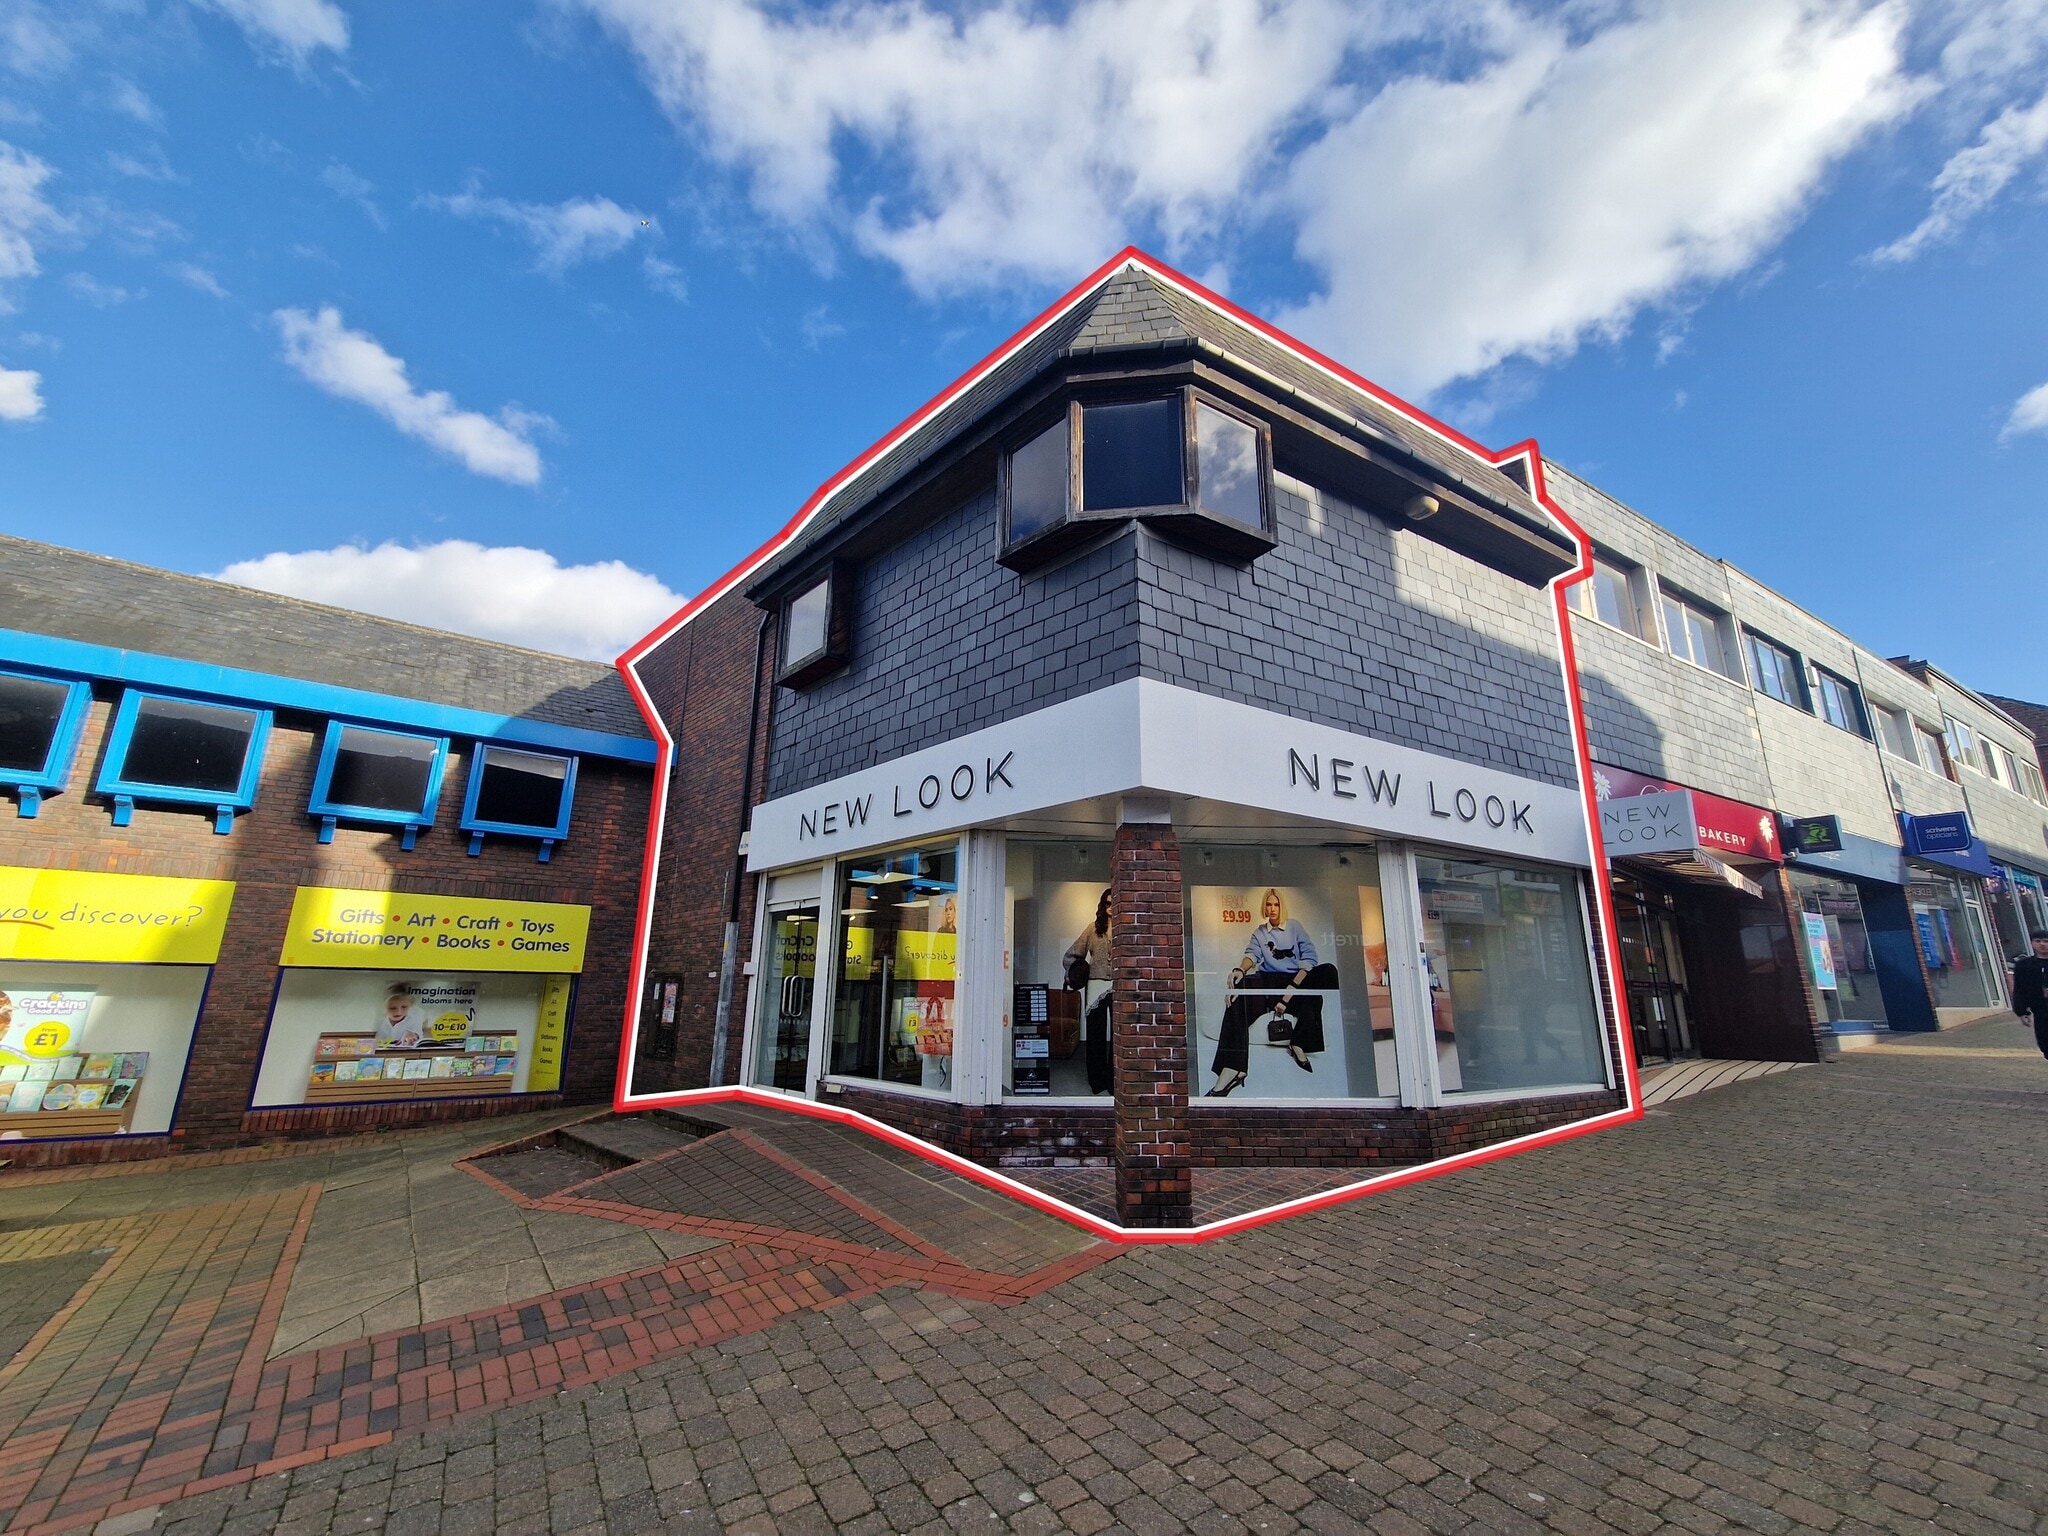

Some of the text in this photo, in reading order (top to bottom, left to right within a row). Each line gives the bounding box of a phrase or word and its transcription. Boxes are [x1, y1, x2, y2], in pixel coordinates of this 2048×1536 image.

[799, 750, 1015, 841] NEW LOOK
[1288, 747, 1534, 835] NEW LOOK
[1603, 803, 1670, 825] NEW
[1698, 826, 1746, 847] BAKERY
[1925, 826, 1958, 834] scrivens
[1926, 832, 1959, 840] opticians
[59, 903, 203, 928] discover?
[339, 908, 555, 936] Gifts Art Craft Toys
[1222, 910, 1252, 923] £9.99
[311, 928, 570, 952] Stationery Books Games
[408, 986, 476, 997] Imagination
[20, 998, 87, 1010] Cracking
[434, 1023, 467, 1031] 10 £10
[33, 1033, 59, 1046] £1
